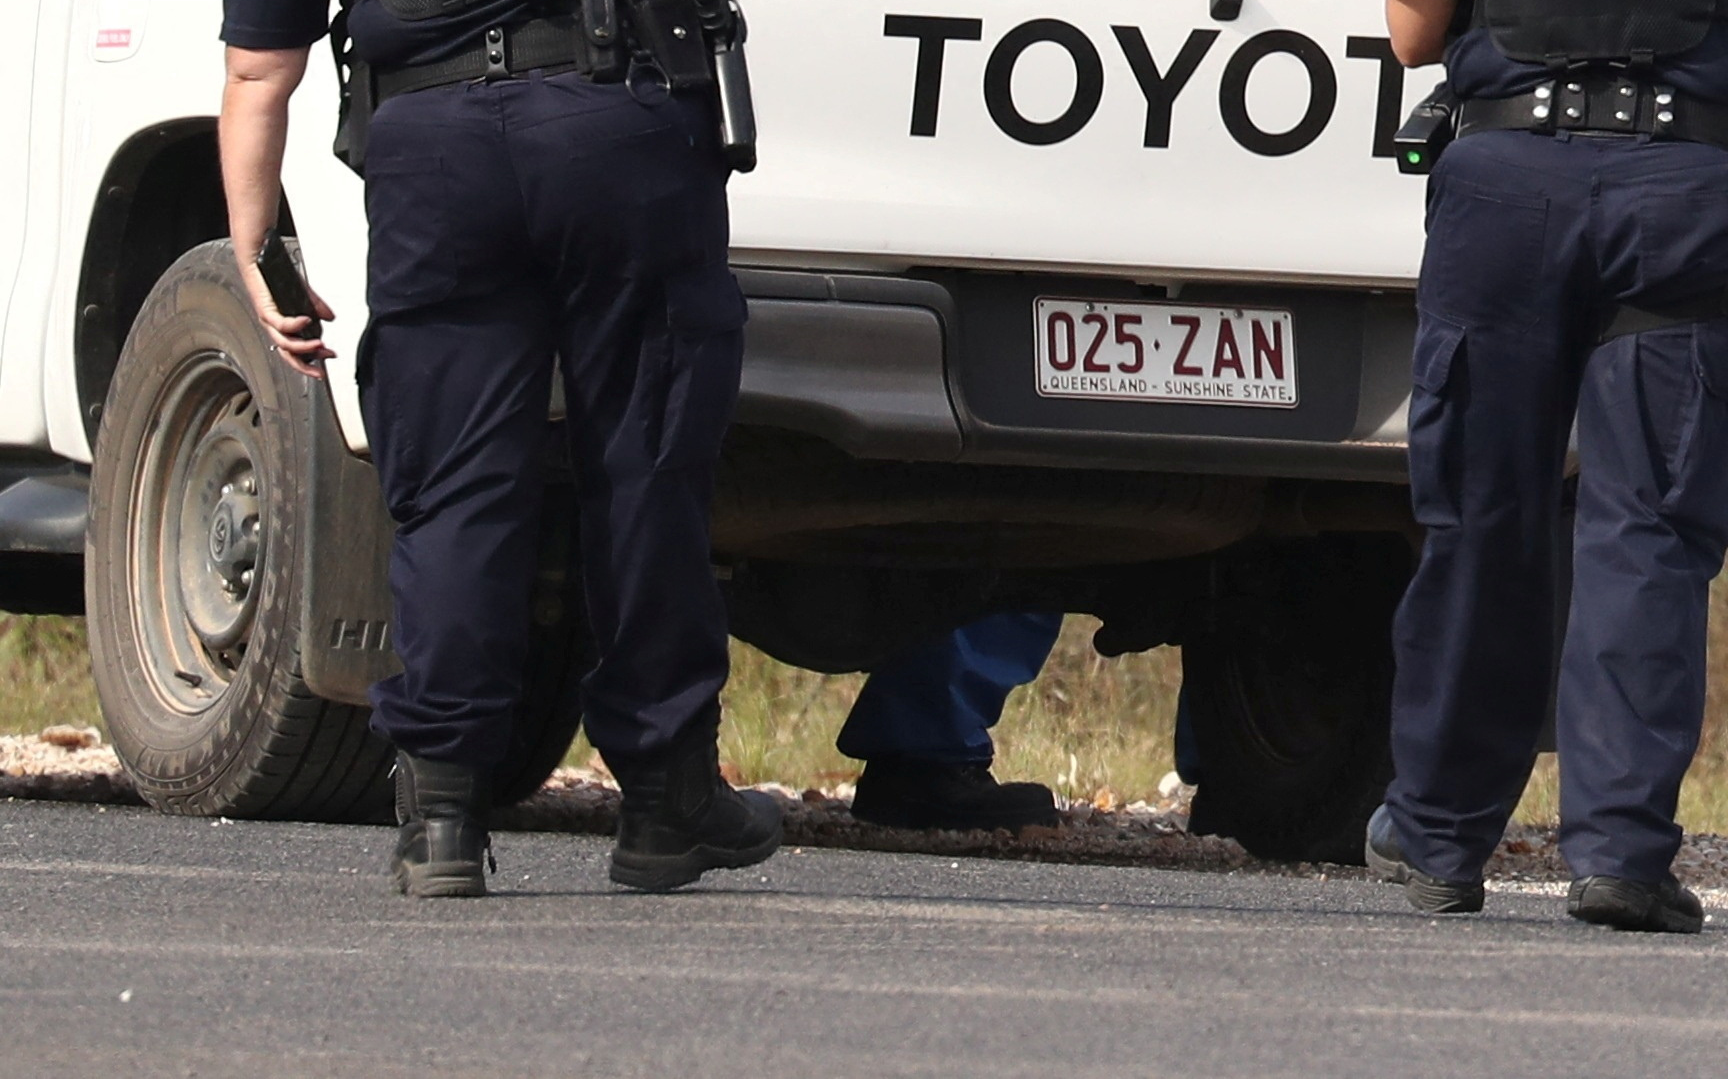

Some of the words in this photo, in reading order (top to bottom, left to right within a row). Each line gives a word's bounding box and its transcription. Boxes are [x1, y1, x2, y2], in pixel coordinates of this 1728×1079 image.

[883, 13, 1406, 159] TOYOT
[1050, 375, 1147, 393] QUEENSLAND
[1165, 380, 1234, 398] SUNSHINE
[1243, 385, 1286, 400] STATE
